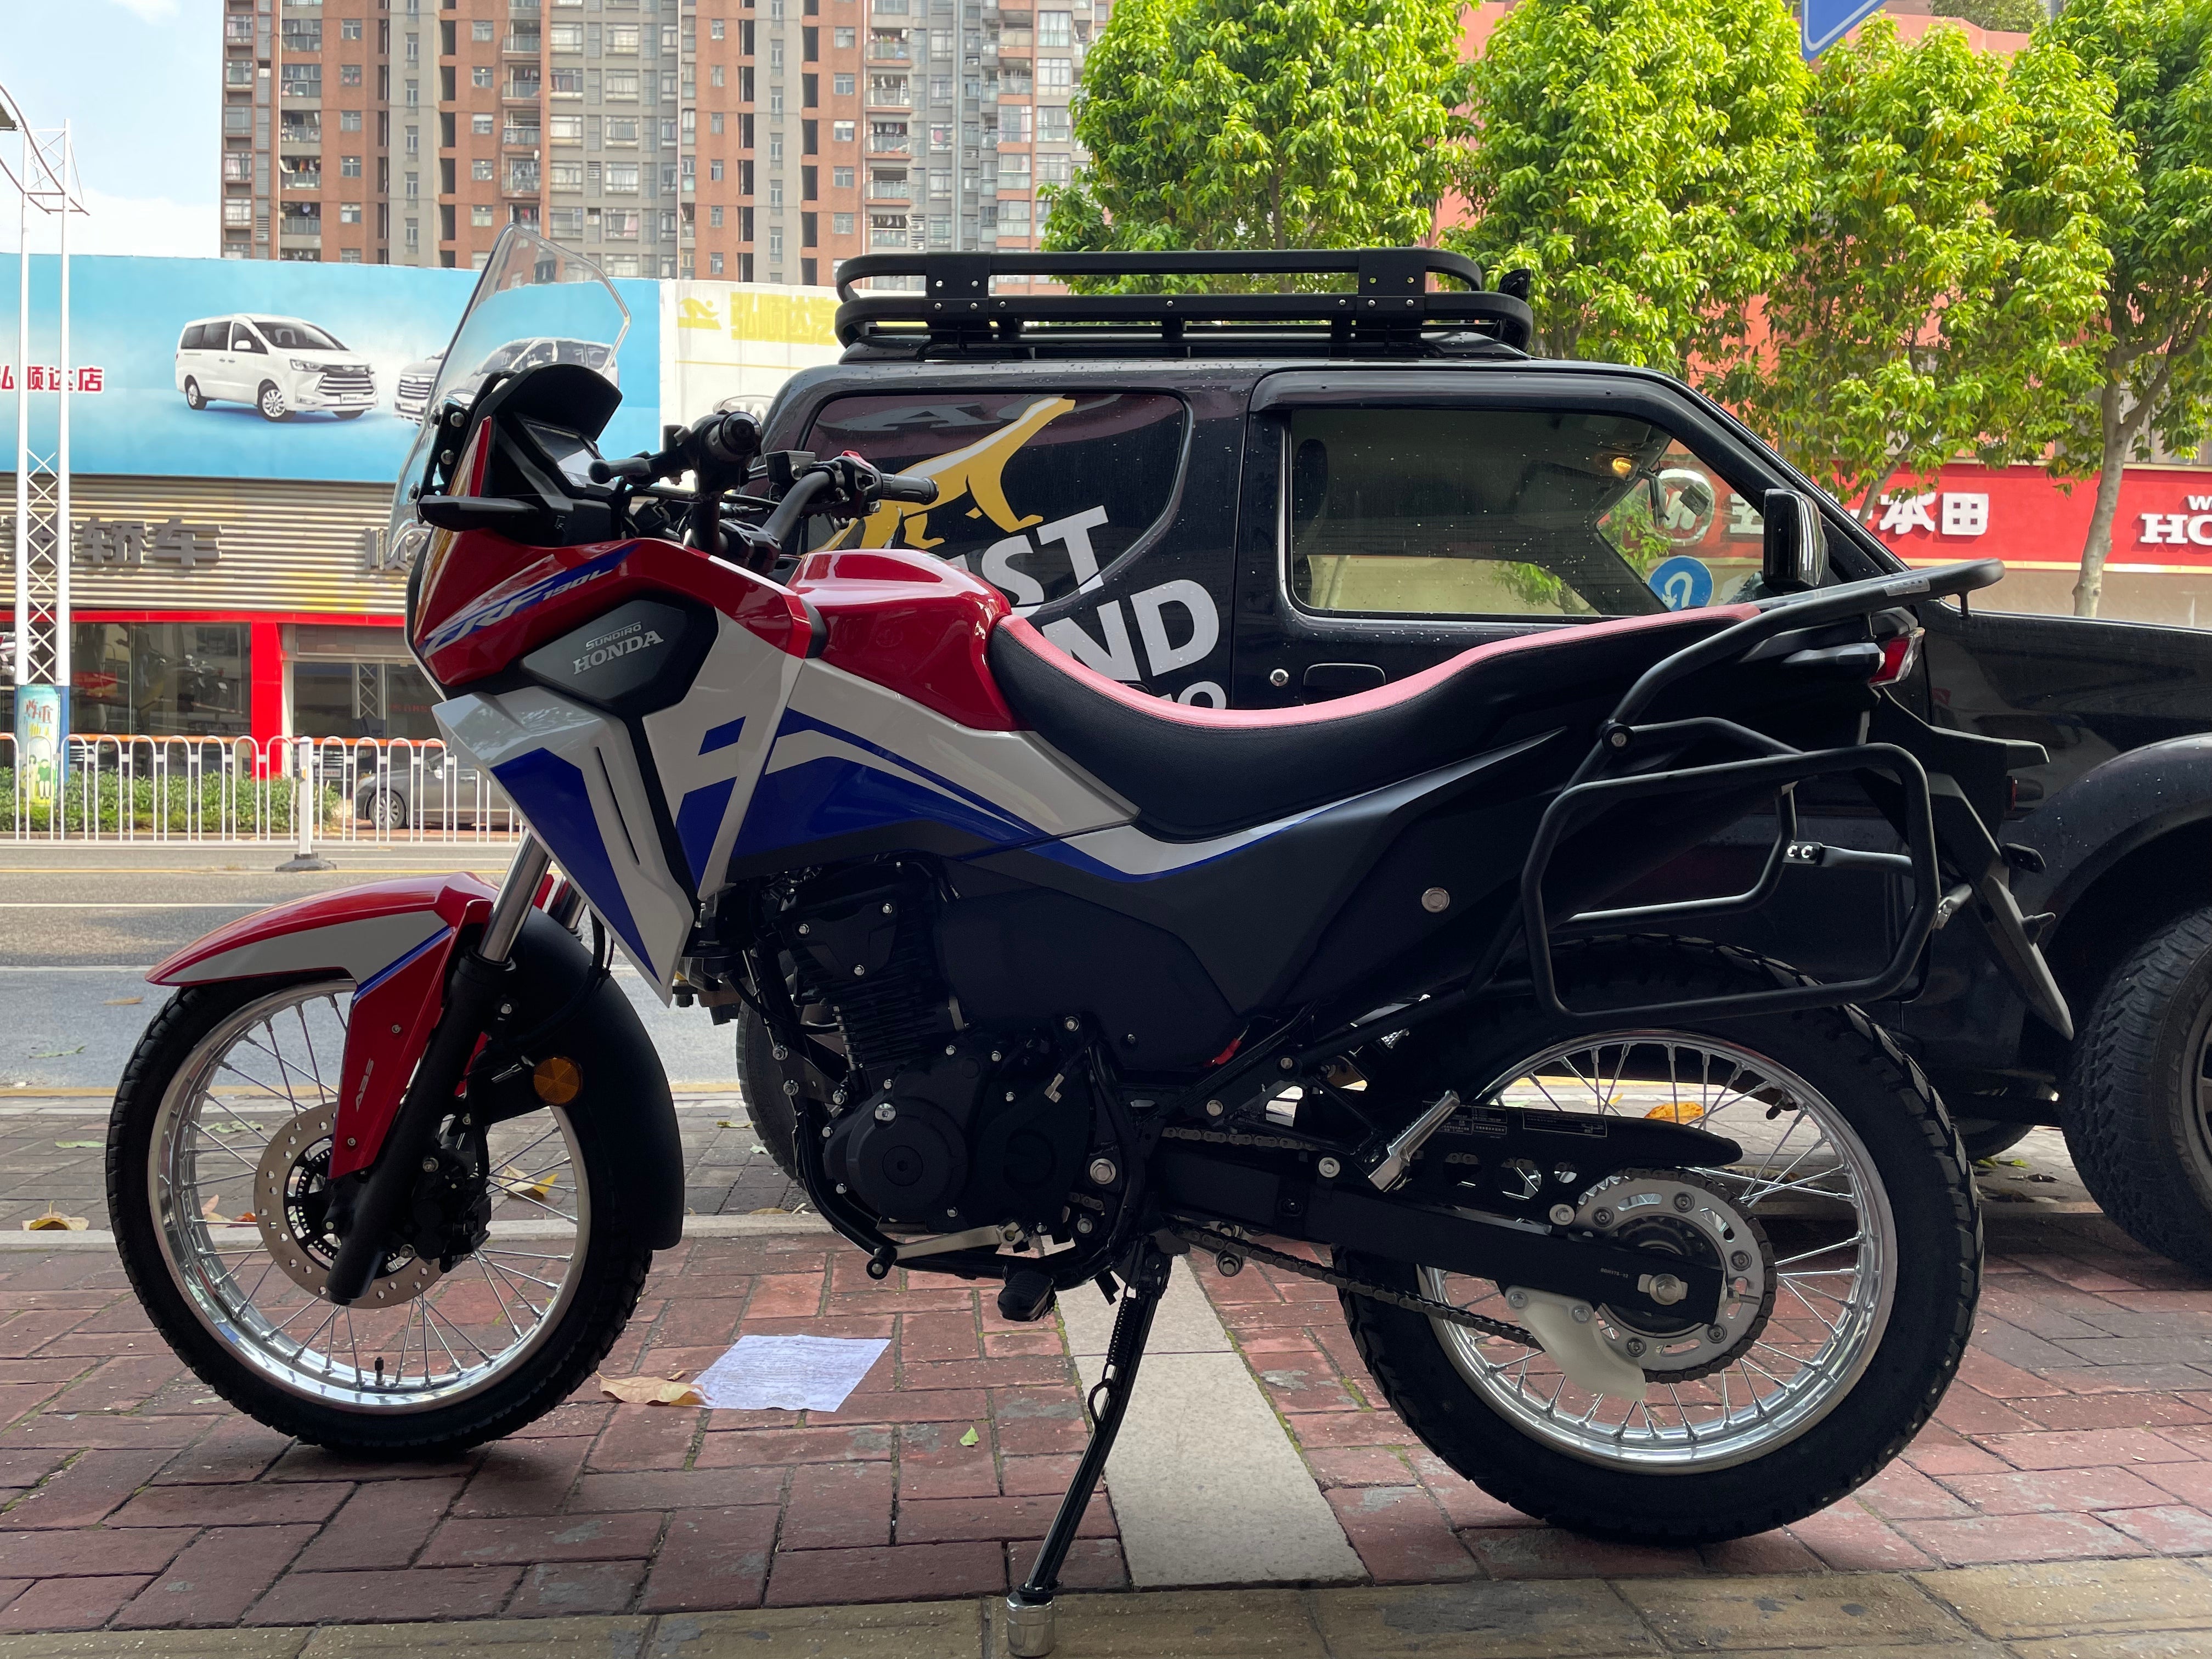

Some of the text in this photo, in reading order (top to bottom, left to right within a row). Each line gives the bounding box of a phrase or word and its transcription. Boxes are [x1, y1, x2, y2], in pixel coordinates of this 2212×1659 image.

[946, 505, 1109, 618] ST
[573, 630, 664, 675] HONDA
[585, 621, 642, 651] SUNDIRO
[356, 1057, 374, 1113] ABS
